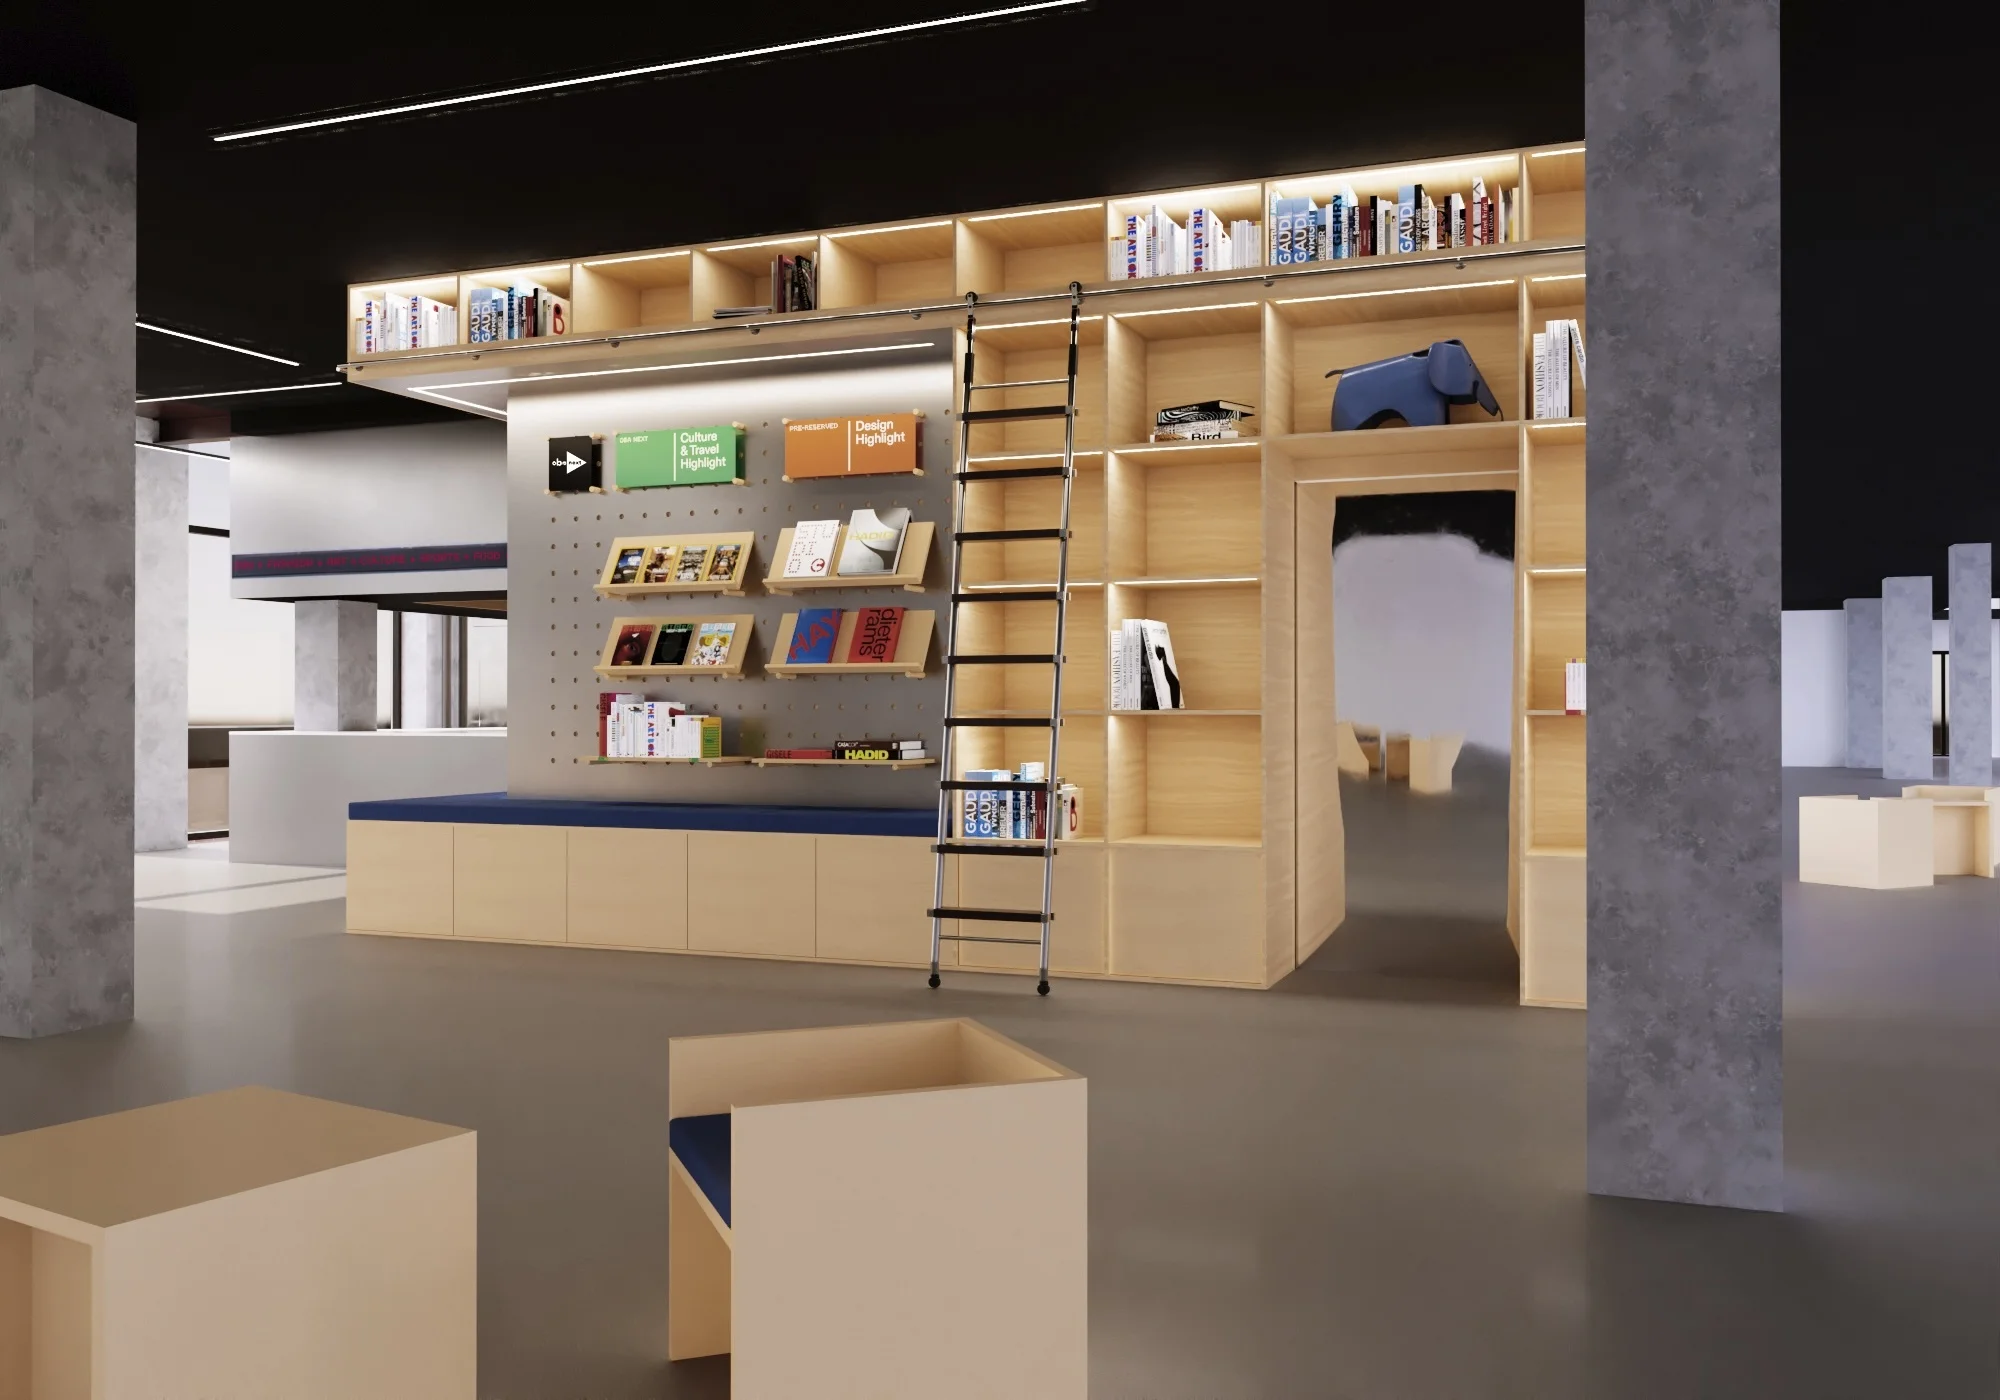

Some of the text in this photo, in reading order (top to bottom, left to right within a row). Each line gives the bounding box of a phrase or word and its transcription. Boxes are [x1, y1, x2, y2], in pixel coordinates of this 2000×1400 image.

[1128, 216, 1136, 236] THE
[1194, 209, 1203, 229] THE
[1333, 195, 1341, 246] GEHRY
[1128, 239, 1136, 256] ART
[1194, 232, 1203, 249] ART
[1535, 355, 1545, 392] FASHION
[789, 422, 838, 432] PRE-RESERVED
[855, 419, 894, 432] Design
[632, 435, 649, 443] NEXT
[680, 432, 718, 444] Culture
[855, 431, 906, 447] Highlight
[1192, 432, 1221, 440] Bird
[680, 444, 719, 456] & Travel
[680, 456, 726, 471] Highlight
[859, 609, 880, 656] rams
[872, 608, 897, 662] dieter
[1112, 650, 1120, 684] FASHION
[845, 750, 889, 760] HADID
[966, 790, 977, 833] GAUD
[981, 790, 991, 833] GAUD
